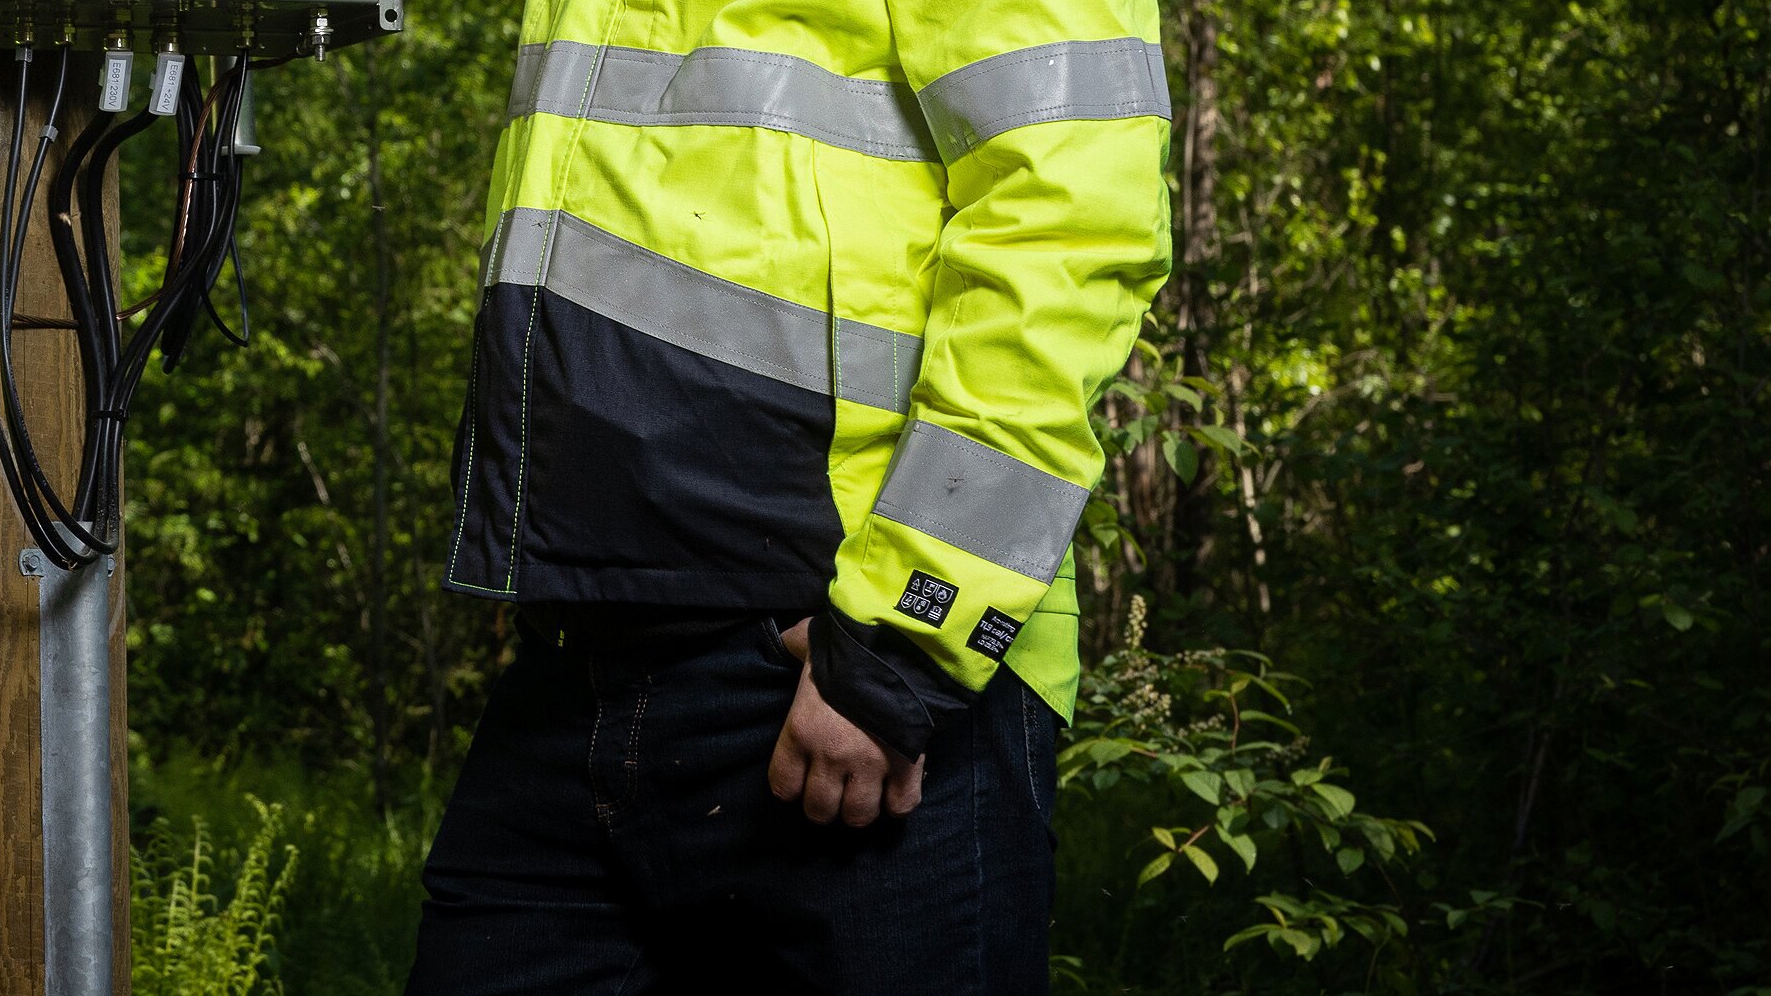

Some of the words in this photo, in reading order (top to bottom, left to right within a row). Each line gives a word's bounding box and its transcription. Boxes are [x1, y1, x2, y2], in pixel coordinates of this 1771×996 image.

[112, 62, 122, 83] E681
[168, 64, 179, 85] E681
[108, 85, 119, 107] 230V
